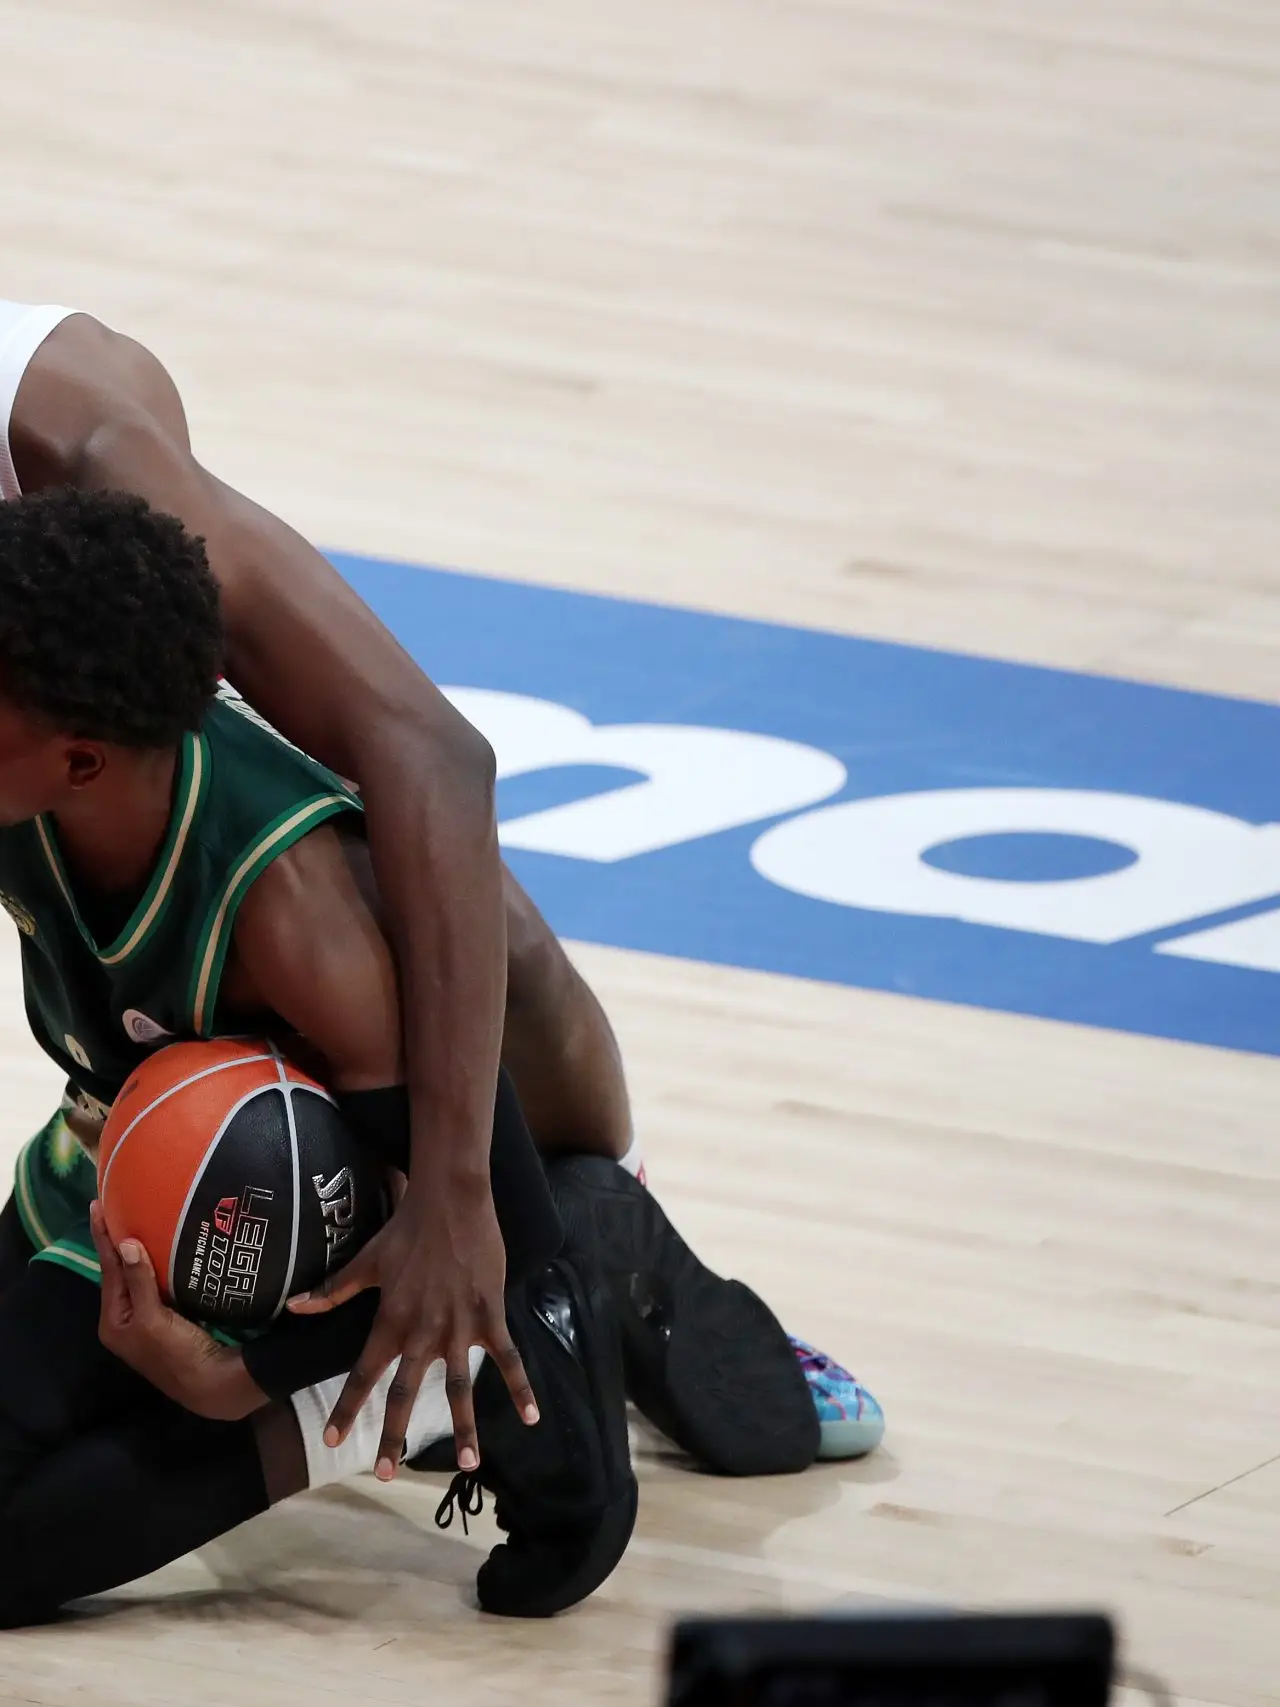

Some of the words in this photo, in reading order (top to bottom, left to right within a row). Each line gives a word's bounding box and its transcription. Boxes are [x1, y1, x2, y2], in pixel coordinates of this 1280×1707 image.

[195, 1220, 210, 1256] OFFICIAL
[221, 1185, 275, 1312] LEGAC
[191, 1257, 203, 1277] GAME
[187, 1275, 200, 1291] BALL
